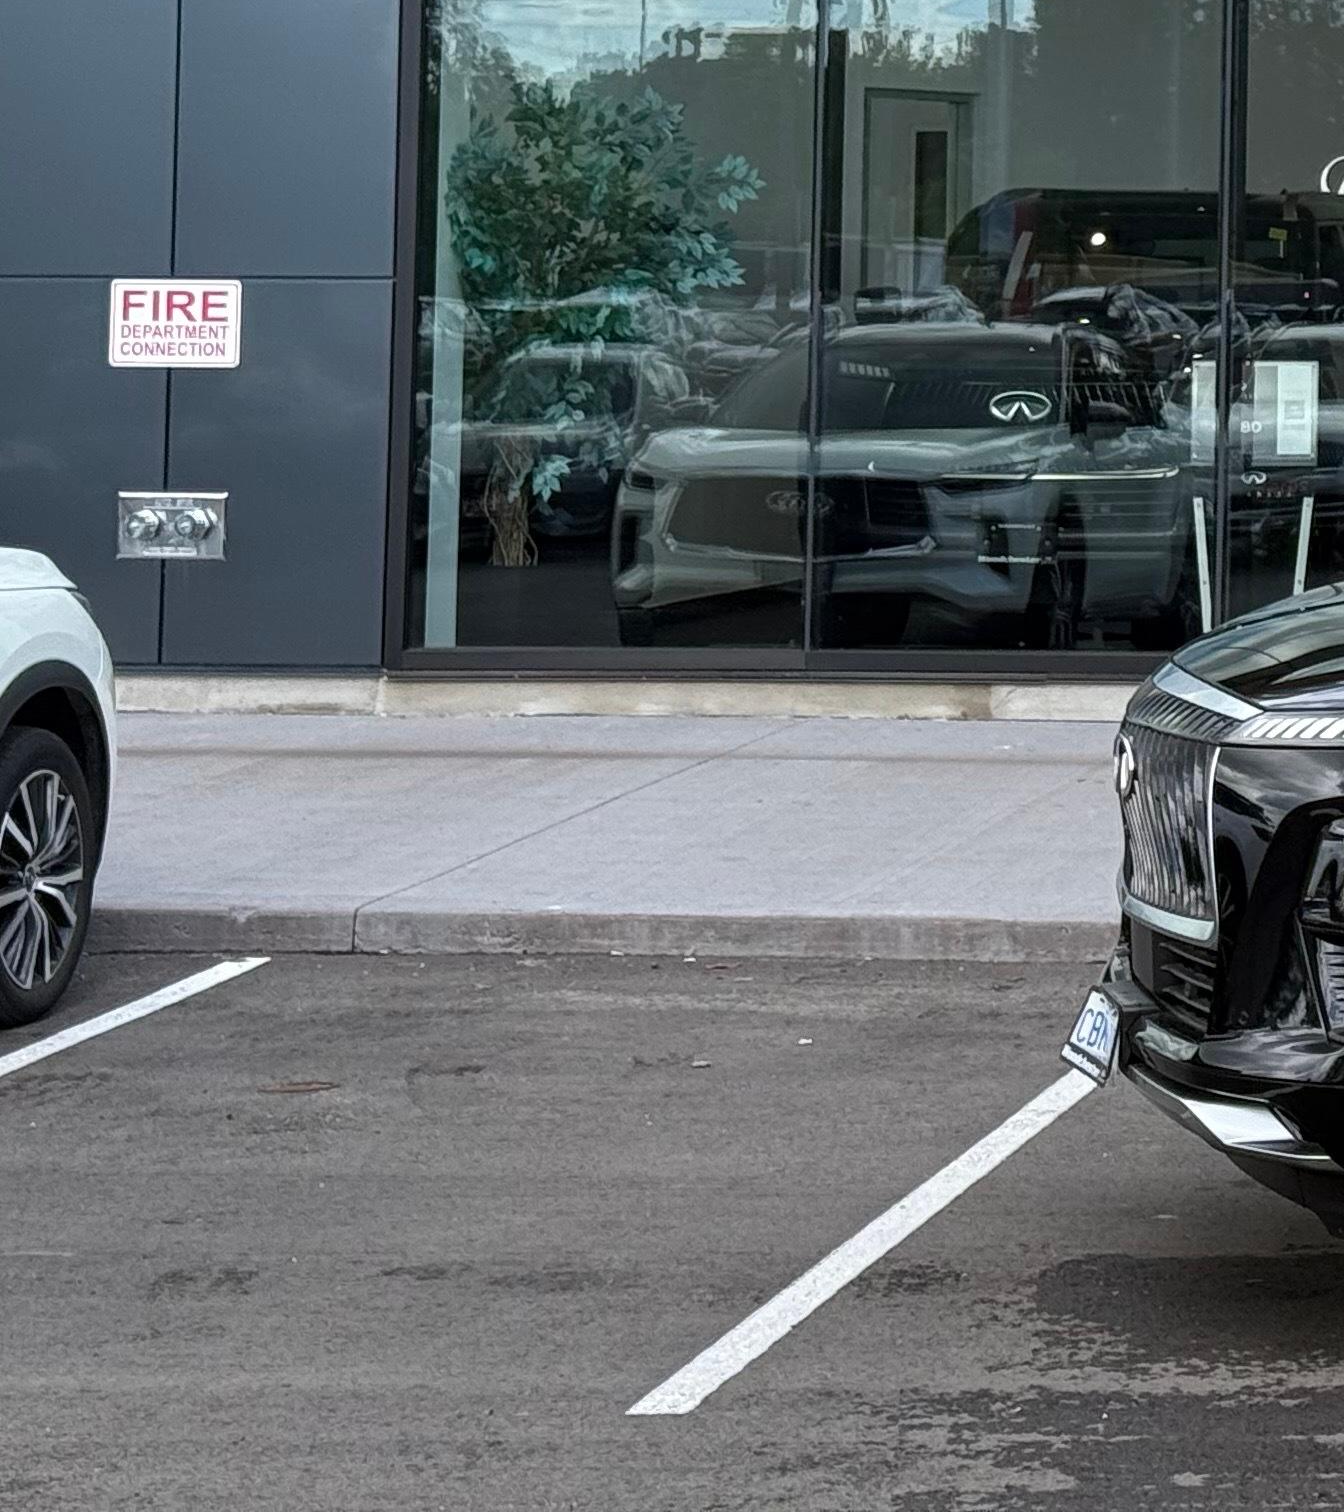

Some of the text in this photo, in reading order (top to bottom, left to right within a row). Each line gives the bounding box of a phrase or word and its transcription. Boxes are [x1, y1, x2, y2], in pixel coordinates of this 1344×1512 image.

[122, 290, 229, 322] FIRE
[120, 324, 230, 340] DEPARTMENT
[119, 341, 226, 357] CONNECTION
